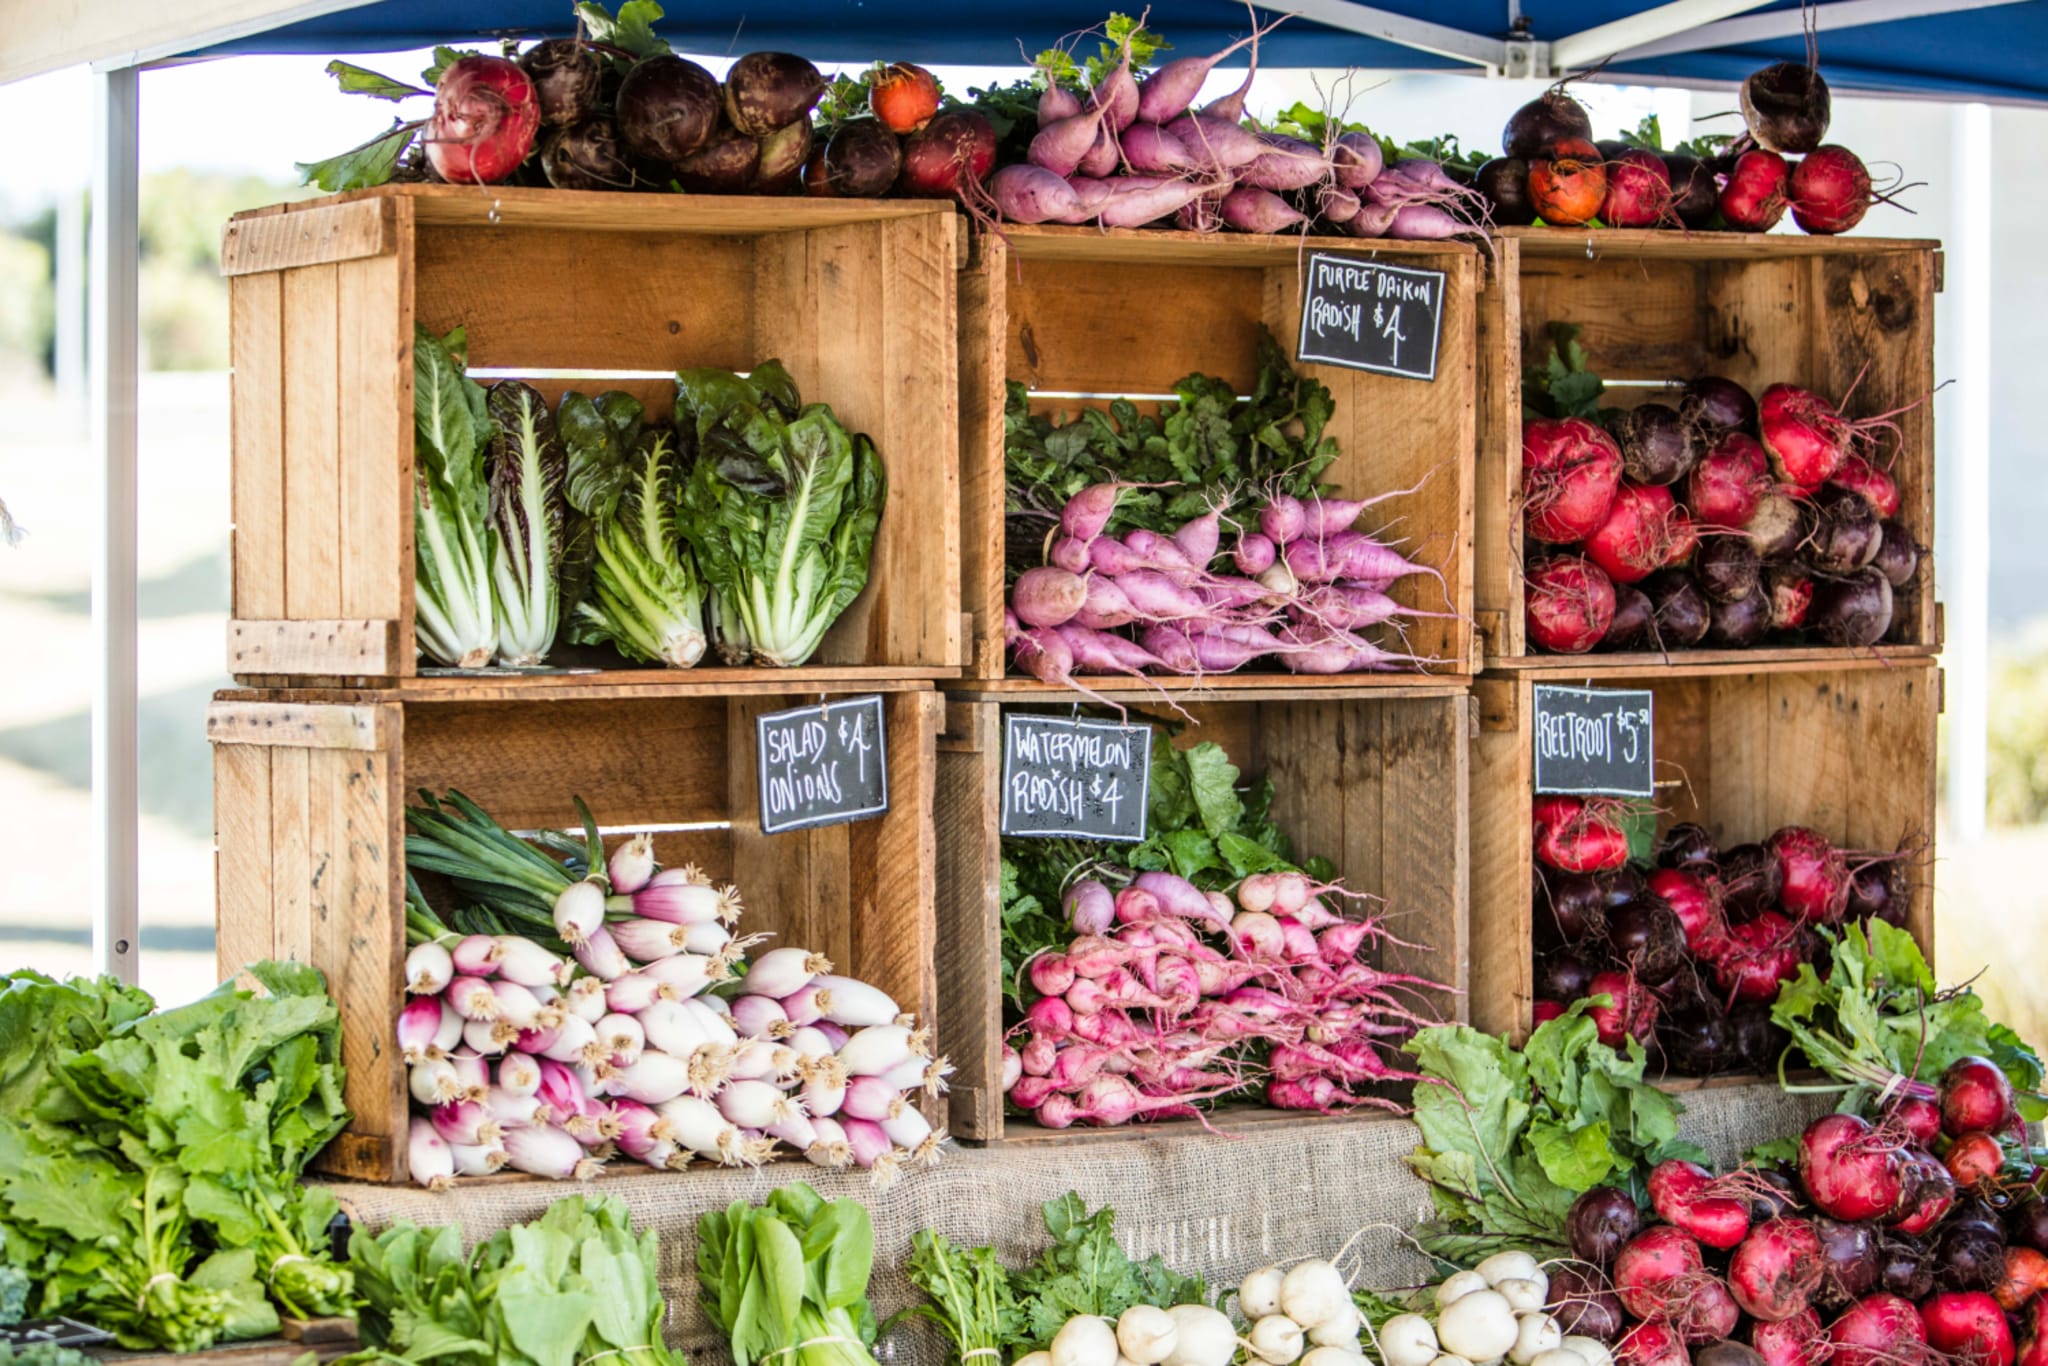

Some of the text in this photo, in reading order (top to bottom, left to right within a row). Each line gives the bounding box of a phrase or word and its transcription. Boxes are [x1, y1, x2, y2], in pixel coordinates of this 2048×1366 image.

[1318, 264, 1370, 293] PURPLE
[1373, 302, 1406, 367] $4
[768, 712, 871, 783] SALAD $4
[1014, 726, 1130, 772] WATERMELON
[1540, 711, 1613, 764] BEETROOT
[1089, 773, 1123, 825] $4
